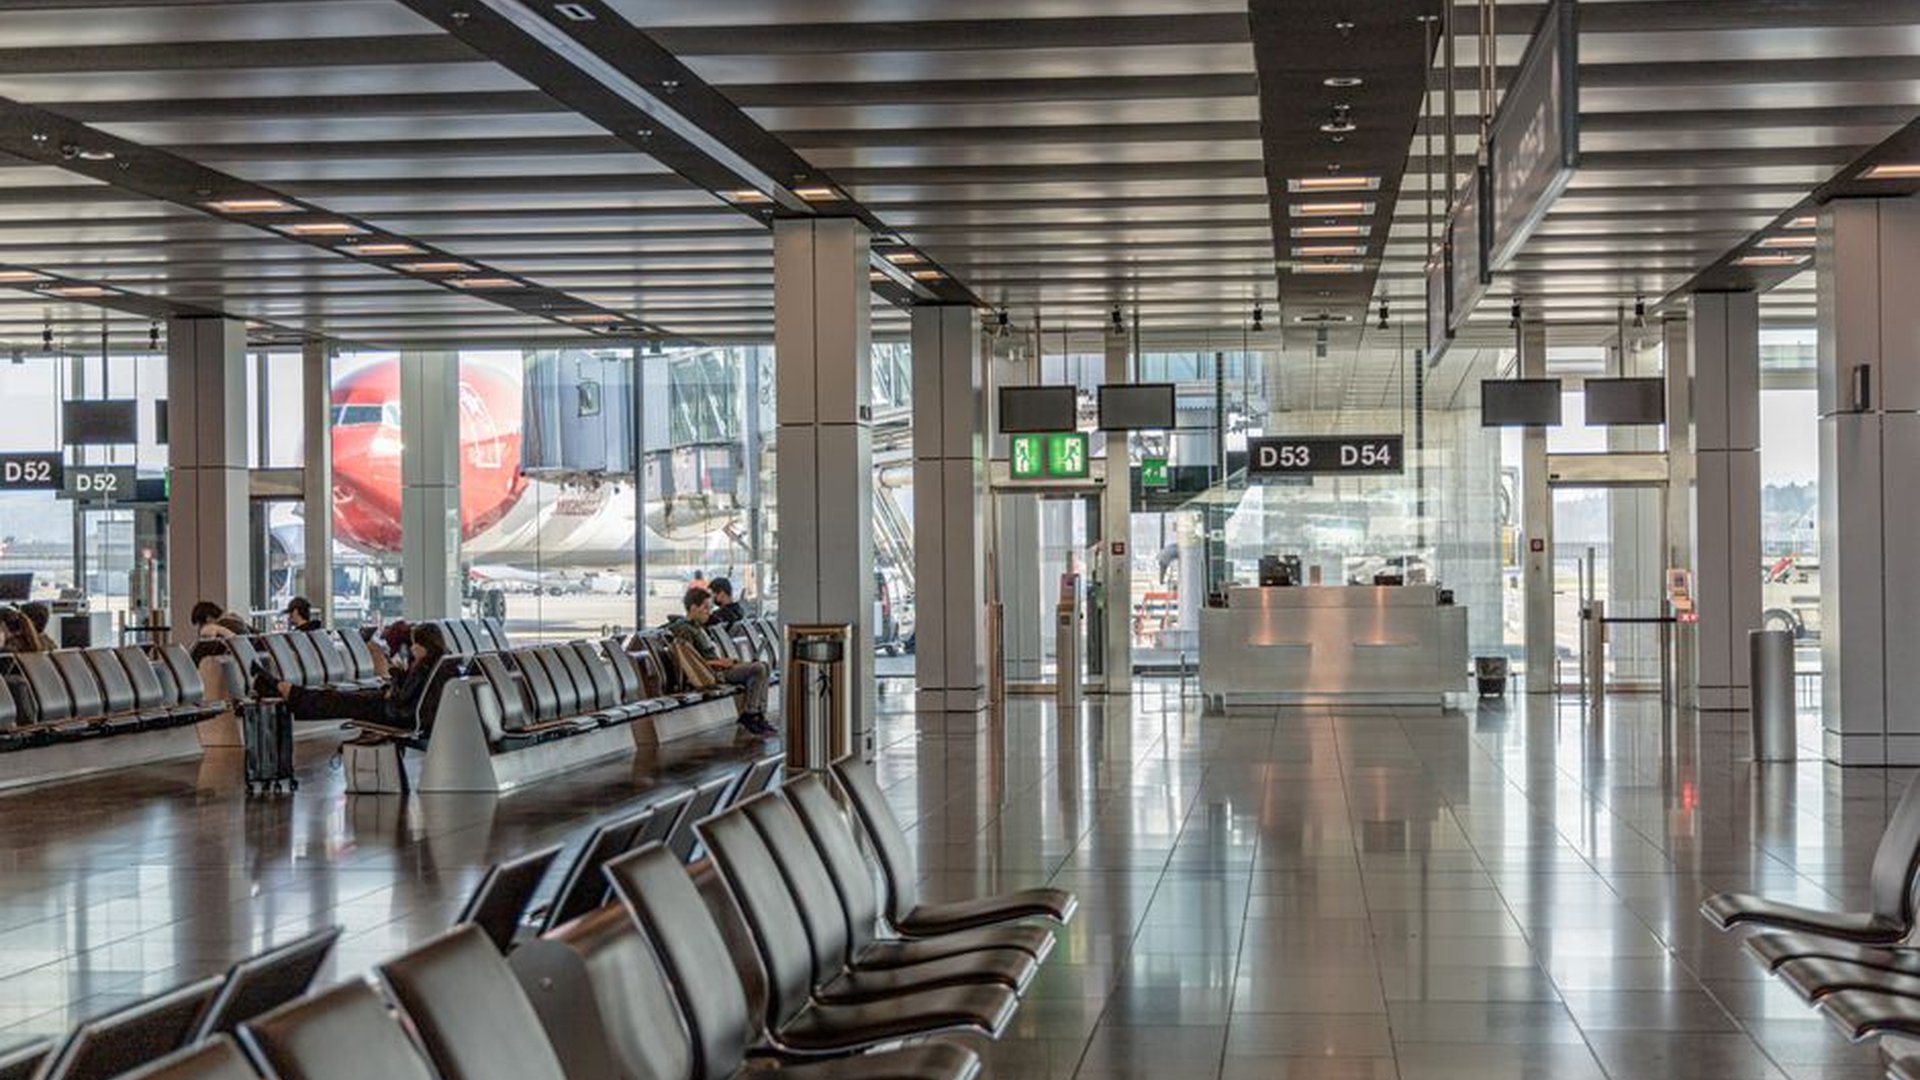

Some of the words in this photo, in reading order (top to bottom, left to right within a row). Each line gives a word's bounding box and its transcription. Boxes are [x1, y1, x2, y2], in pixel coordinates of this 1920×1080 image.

[1259, 446, 1311, 468] D53
[1340, 444, 1391, 467] D54
[5, 461, 51, 482] D52
[76, 473, 117, 492] D52
